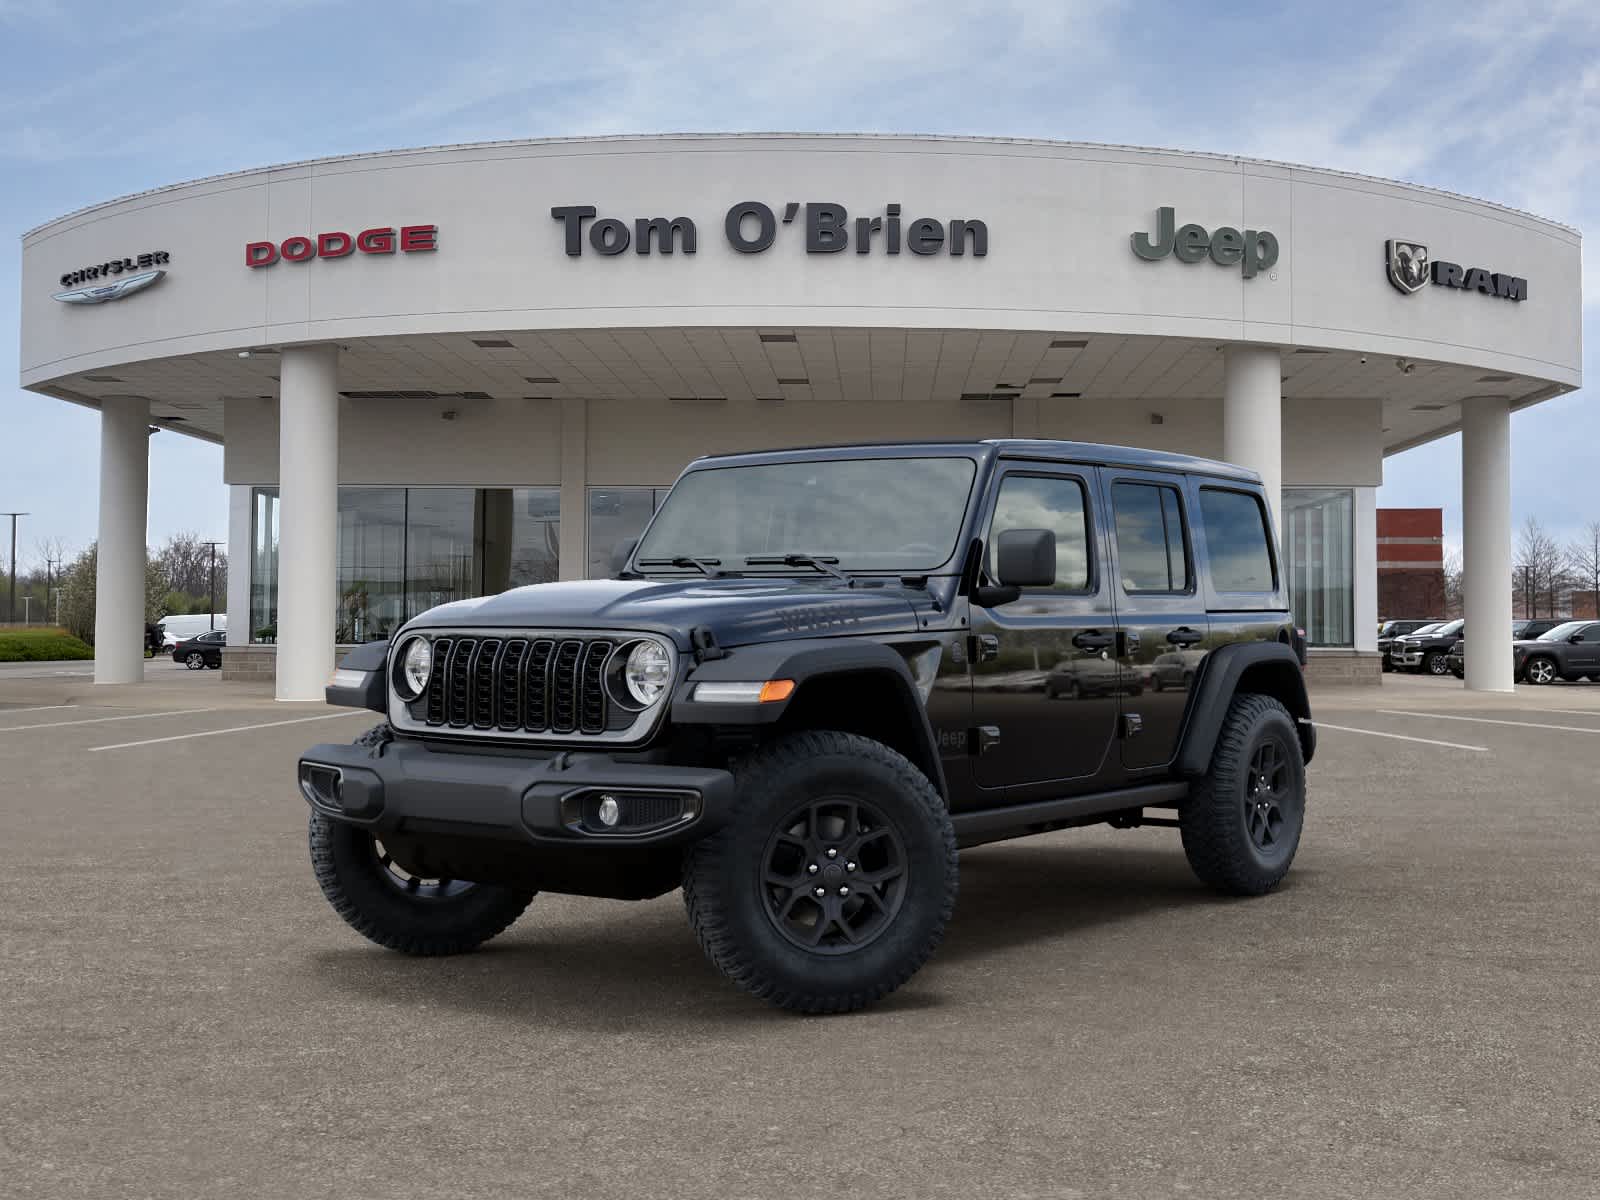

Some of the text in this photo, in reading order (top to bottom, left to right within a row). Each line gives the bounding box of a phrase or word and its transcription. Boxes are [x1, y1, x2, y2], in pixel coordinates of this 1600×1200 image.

[245, 224, 437, 269] DODGE
[551, 205, 697, 256] Tom
[1130, 206, 1279, 279] Jeep
[60, 249, 170, 287] CHRYSLER
[1431, 260, 1528, 301] RAM
